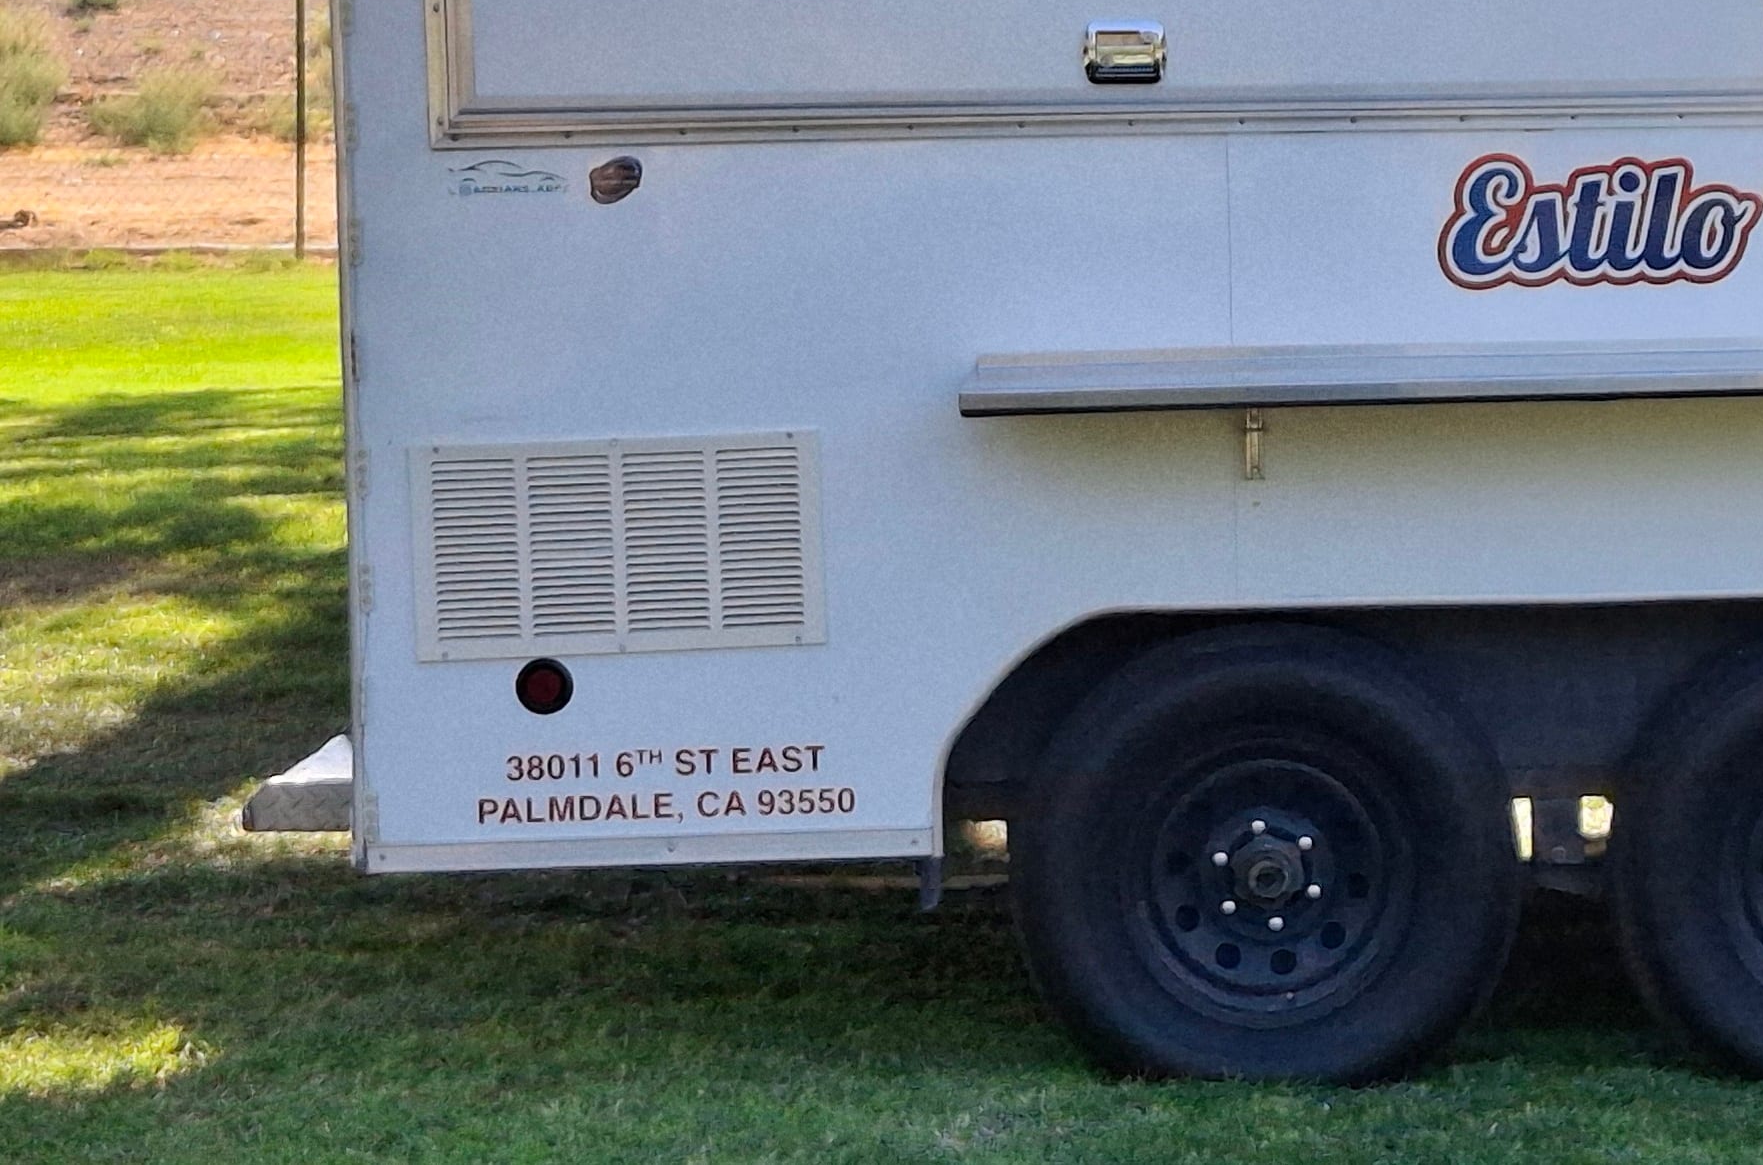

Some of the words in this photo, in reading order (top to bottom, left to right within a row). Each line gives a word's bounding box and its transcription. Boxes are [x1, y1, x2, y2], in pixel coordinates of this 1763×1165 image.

[1437, 153, 1763, 290] Estilo
[507, 753, 599, 781] 38011
[676, 749, 719, 776] ST
[732, 746, 825, 774] EAST
[478, 793, 683, 824] PALMDALE,
[697, 790, 746, 817] CA
[758, 788, 855, 815] 93550
